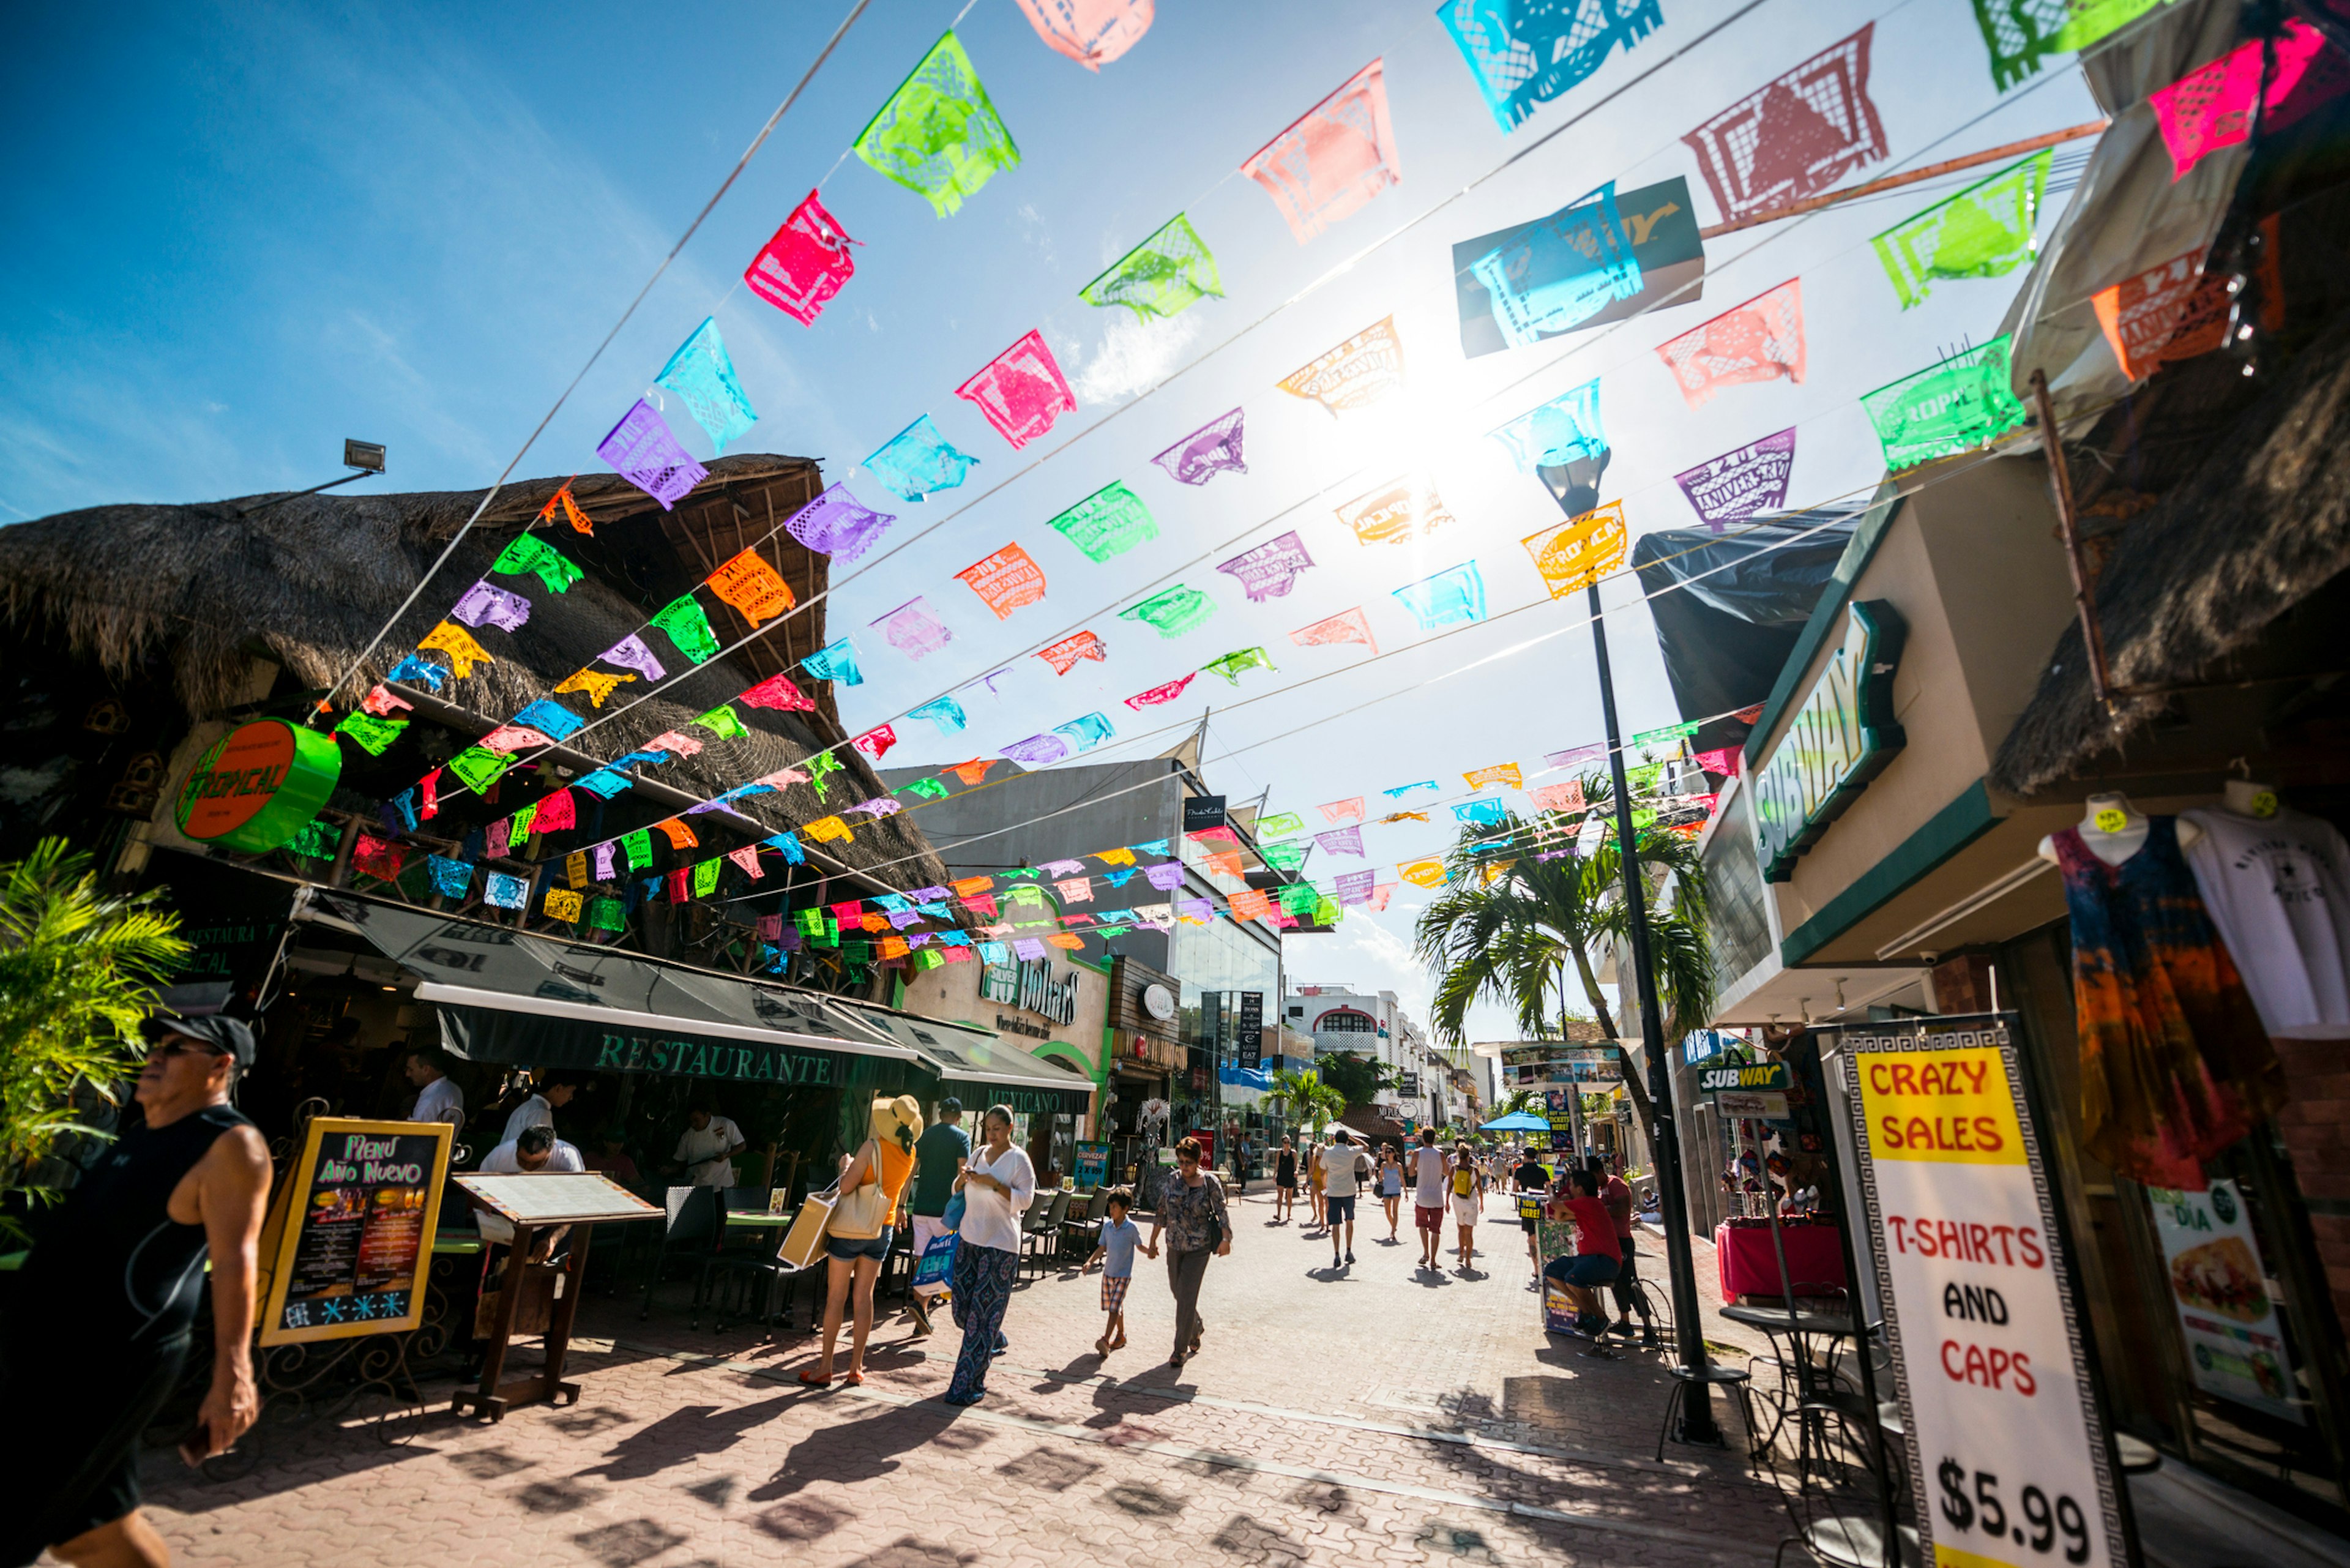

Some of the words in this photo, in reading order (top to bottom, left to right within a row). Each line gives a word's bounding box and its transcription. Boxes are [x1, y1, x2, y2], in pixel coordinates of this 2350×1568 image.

[1756, 614, 1869, 868] SUBWAY
[184, 764, 280, 799] TROPICAL
[990, 965, 1018, 985] SILVER
[595, 1034, 832, 1085] RESTAURANTE
[1701, 1064, 1781, 1089] SUBWAY
[1870, 1061, 1987, 1096] CRAZY
[987, 1088, 1060, 1112] MEXICANO
[1881, 1116, 2004, 1152] SALES
[1077, 1151, 1107, 1162] CERVEZAS
[1520, 1208, 1540, 1219] HERE!
[1887, 1215, 2046, 1269] T-SHIRTS
[1944, 1282, 2010, 1326] AND
[1941, 1340, 2037, 1398] CAPS
[1938, 1455, 2091, 1566] $5.99
